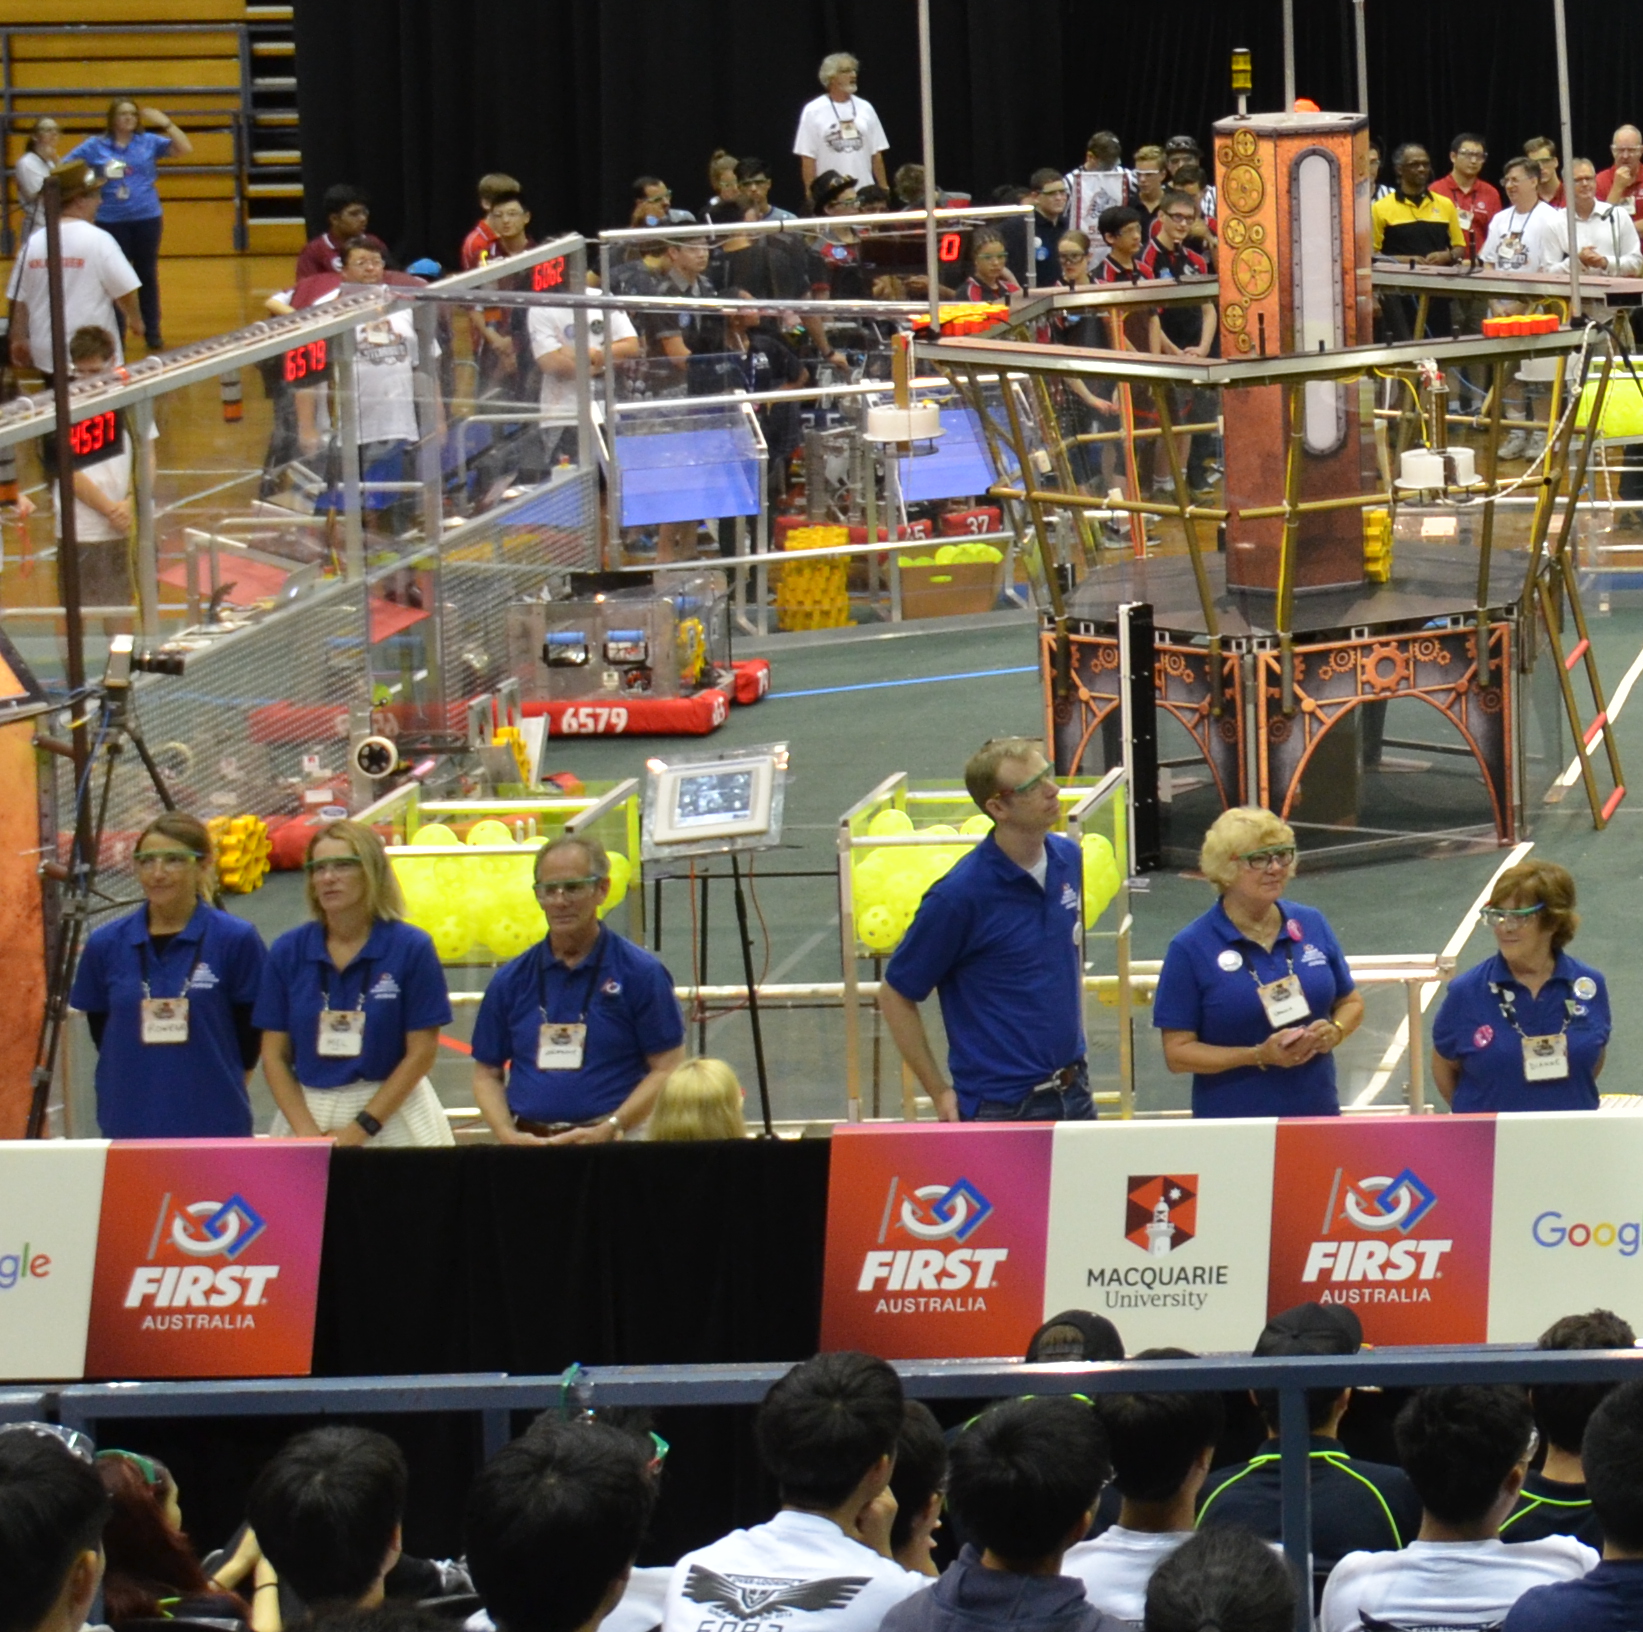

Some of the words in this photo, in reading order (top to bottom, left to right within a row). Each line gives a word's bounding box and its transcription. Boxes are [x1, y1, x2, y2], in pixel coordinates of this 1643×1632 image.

[285, 339, 326, 382] 6579
[561, 707, 629, 734] 6579
[857, 1247, 1009, 1292] FIRST
[1301, 1239, 1453, 1283] FIRST
[124, 1264, 281, 1309] FIRST
[1086, 1264, 1229, 1290] MACQUARIE
[874, 1296, 987, 1314] AUSTRALIA
[1104, 1288, 1209, 1310] University
[1319, 1287, 1432, 1305] AUSTRALIA
[141, 1314, 256, 1331] AUSTRALIA
